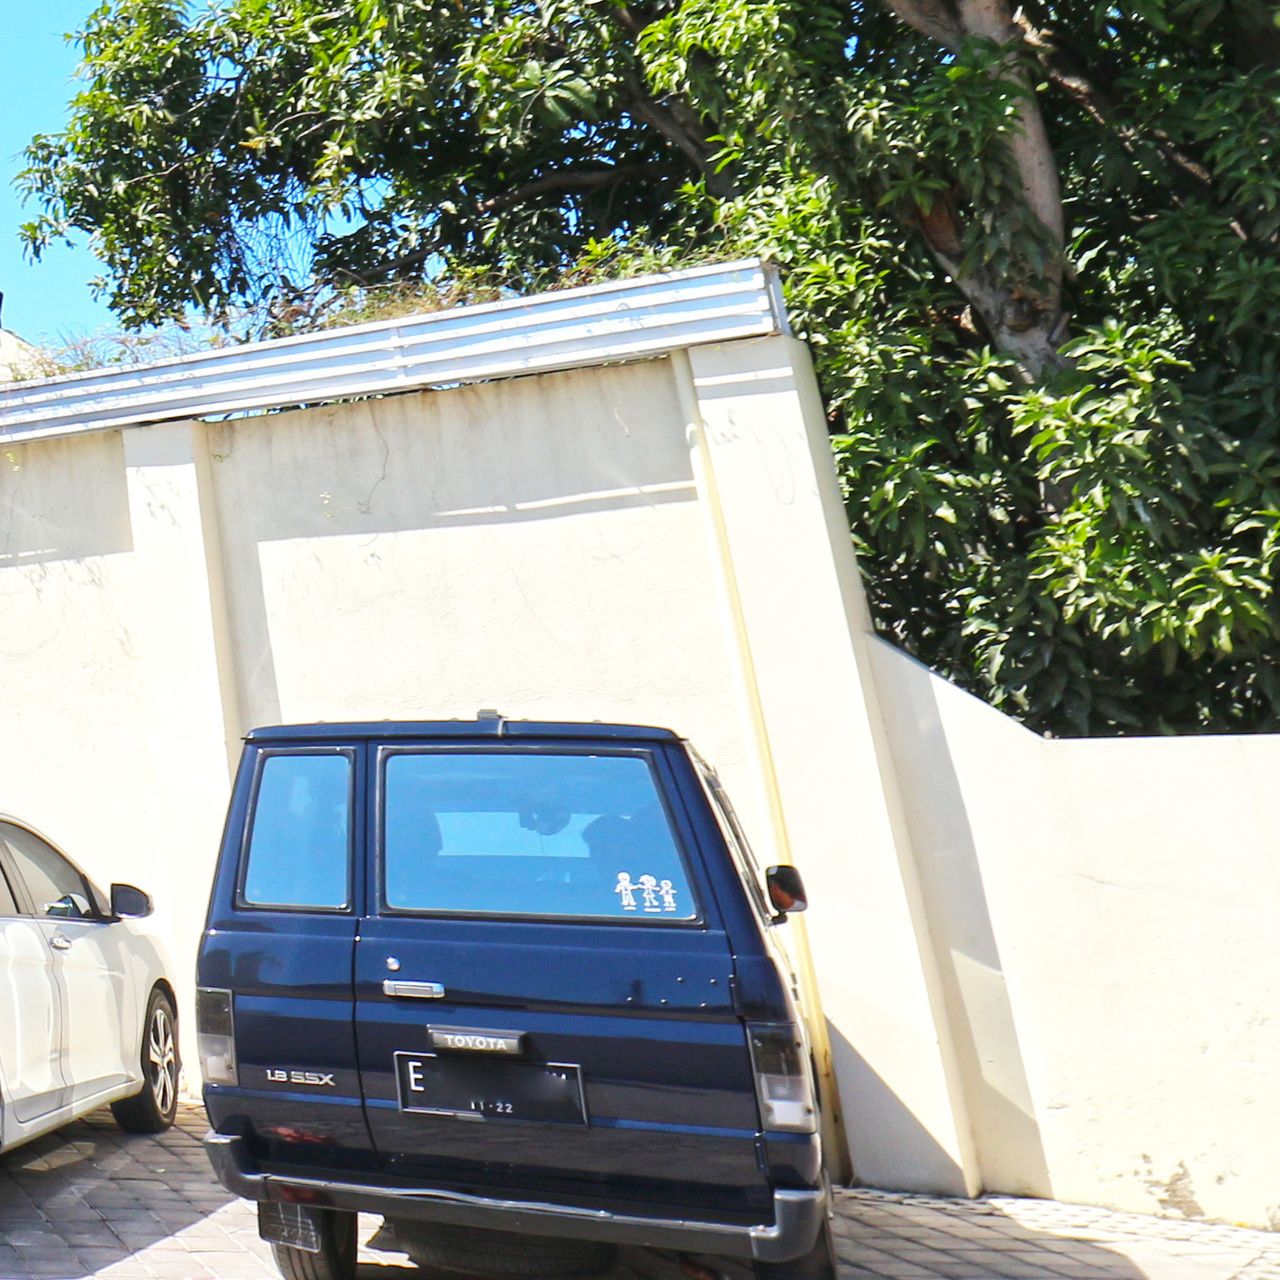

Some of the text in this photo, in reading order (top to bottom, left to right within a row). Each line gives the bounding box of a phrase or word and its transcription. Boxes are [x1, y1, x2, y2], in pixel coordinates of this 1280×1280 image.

[443, 1034, 509, 1051] TOYOTA
[290, 1070, 337, 1087] SSX
[407, 1060, 426, 1092] E
